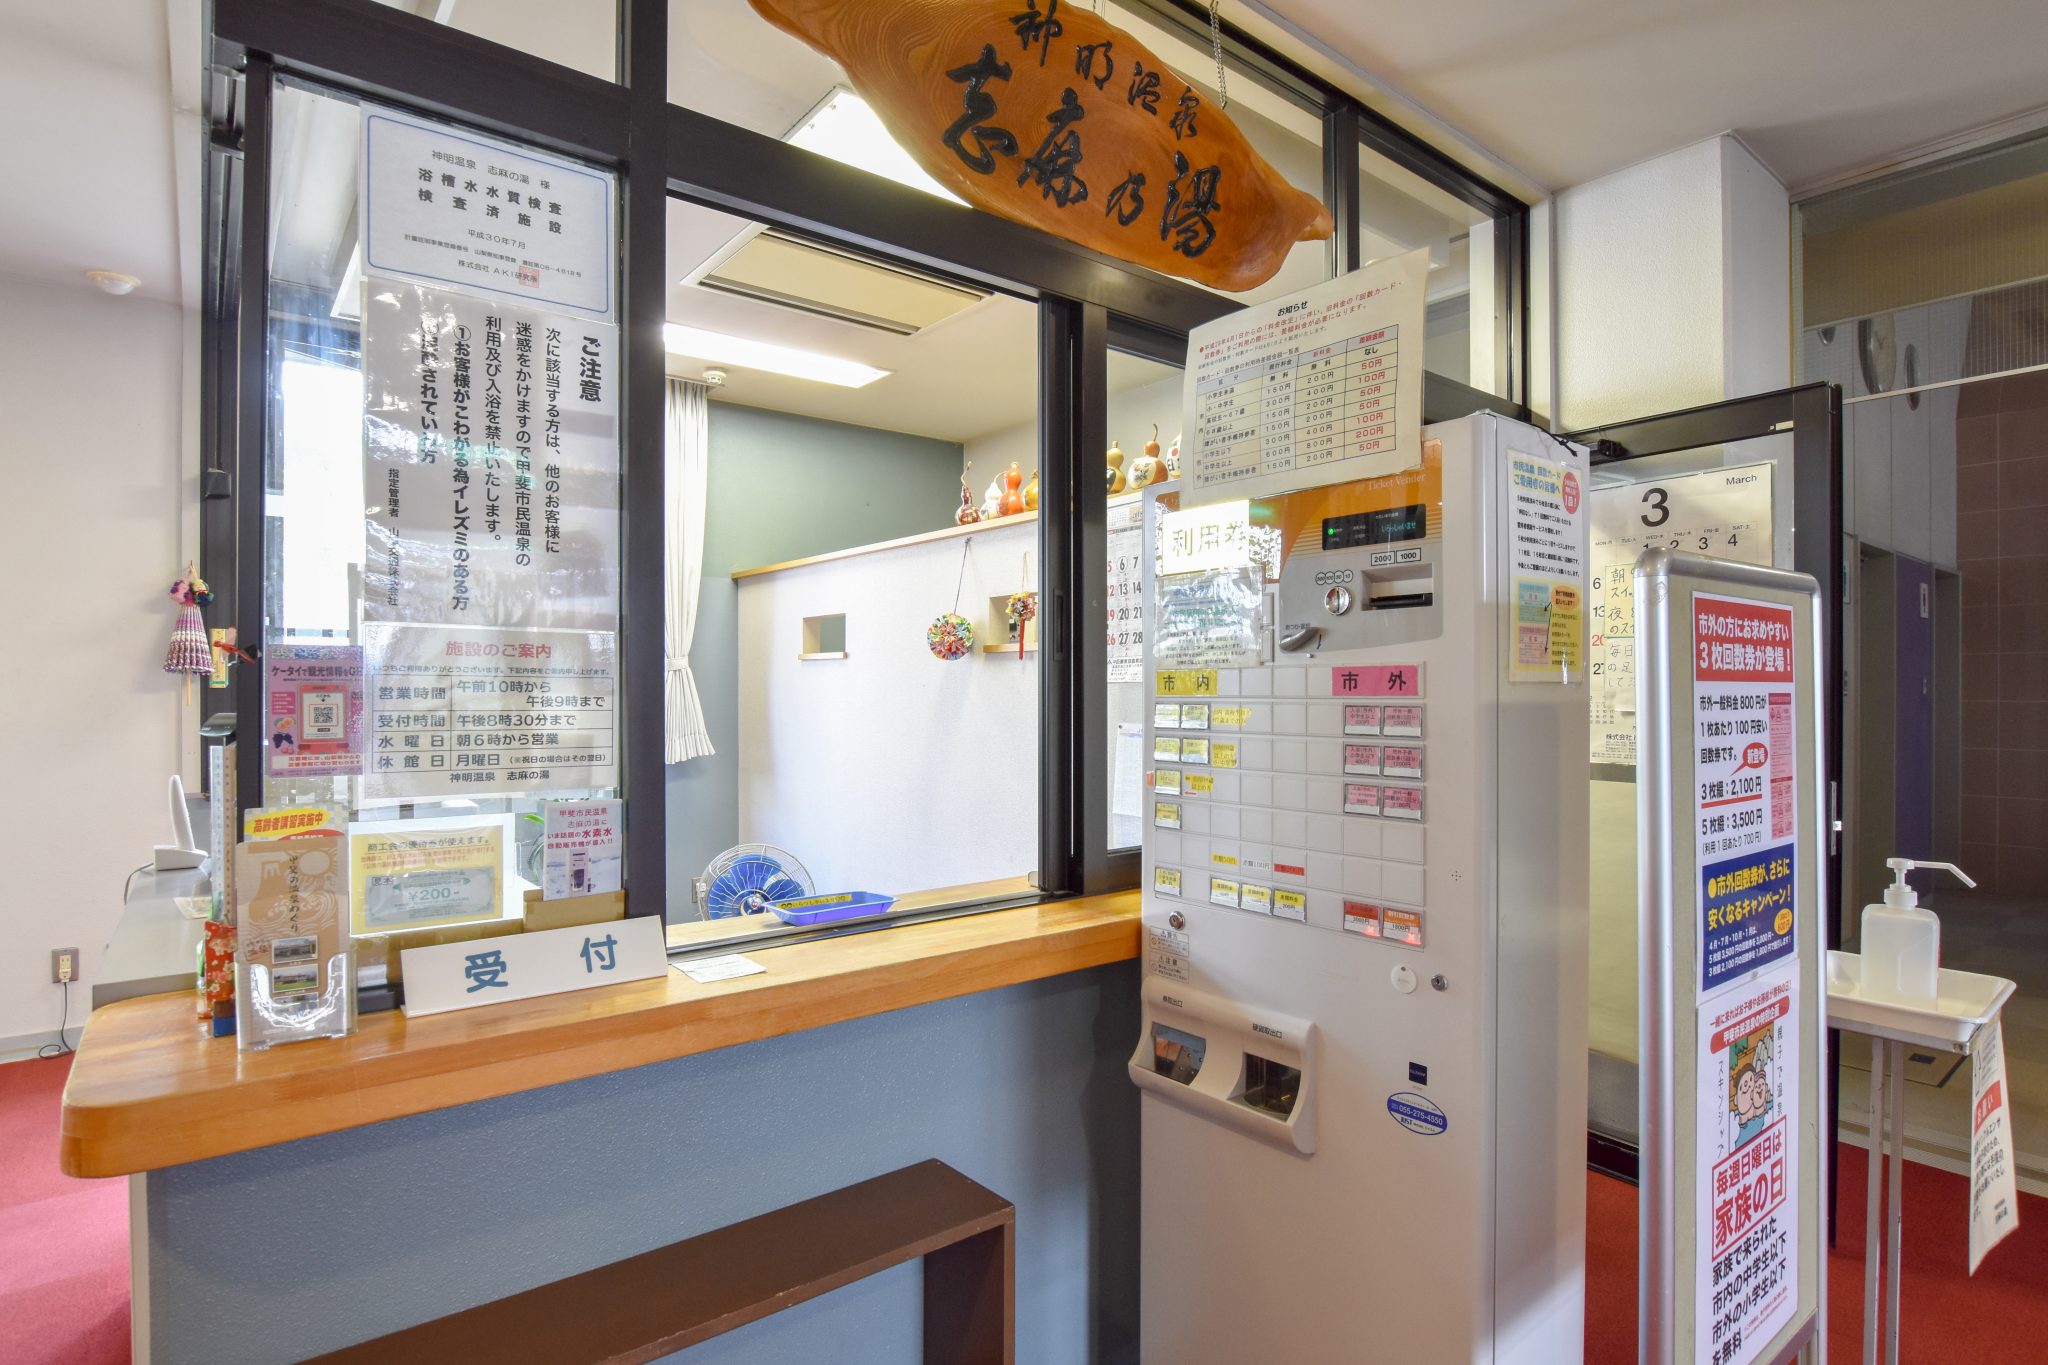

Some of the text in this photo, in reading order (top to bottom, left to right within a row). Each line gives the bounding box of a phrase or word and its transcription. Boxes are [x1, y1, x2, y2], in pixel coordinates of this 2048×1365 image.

[1009, 0, 1199, 141] 神明温泉
[942, 43, 1221, 258] 志麻乃湯
[431, 150, 477, 170] 神明温泉
[487, 164, 530, 185] 志麻の湯
[418, 167, 562, 216] 浴槽水水質検査
[418, 188, 562, 234] 検査済施設
[468, 228, 526, 250] 平成30年7月
[458, 259, 489, 273] 株式会社
[1277, 300, 1309, 317] お知らせ
[1364, 346, 1379, 355] なし
[579, 335, 602, 402] ご注意
[1307, 370, 1334, 384] 200円
[1361, 358, 1383, 370] 50円
[1307, 384, 1334, 397] 400円
[1359, 371, 1386, 384] 100円
[1306, 397, 1333, 410] 200円
[1360, 385, 1381, 397] 50円
[1306, 410, 1333, 423] 200円
[1359, 399, 1380, 410] 50円
[485, 315, 502, 541] 利用及び入浴を禁止いたします。
[1306, 424, 1333, 435] 400円
[1356, 412, 1384, 425] 100円
[1355, 425, 1384, 438] 200円
[515, 321, 532, 567] 迷惑をかけますので甲斐市民温泉の
[544, 327, 561, 554] 次に該当する方は、他のお客様に
[1306, 450, 1333, 462] 200円
[1359, 440, 1380, 452] 50円
[1726, 474, 1757, 486] March
[388, 468, 399, 518] 指定管理者
[1641, 487, 1670, 528] 3
[1698, 537, 1709, 550] 3
[1727, 533, 1738, 547] 4
[1119, 557, 1125, 571] 6
[1132, 556, 1138, 569] 7
[1374, 552, 1417, 563] 2000 1000
[1592, 577, 1601, 590] 6
[1611, 568, 1625, 584] 朝
[1118, 581, 1142, 596] 13 14
[1118, 608, 1129, 621] 20
[1608, 606, 1624, 621] 夜
[1698, 612, 1789, 641] 市外の方にお求めやすい
[1118, 633, 1129, 645] 27
[1132, 631, 1142, 644] 28
[446, 640, 552, 659] 施設のご案内
[1699, 641, 1791, 672] 3枚回数券が登場!
[379, 679, 551, 700] 営業時間 午前10時から
[1163, 674, 1210, 692] 市内
[1341, 671, 1407, 692] 市外
[526, 695, 605, 708] 午後9時まで
[1699, 694, 1767, 711] 市外一般料金800円が
[378, 713, 577, 728] 受付時間 午後8時30分まで
[1700, 719, 1768, 738] 1枚あたり100円安い
[378, 733, 559, 749] 水曜日 朝6時から営業
[378, 754, 445, 769] 休館日
[456, 753, 501, 767] 月曜日
[1700, 747, 1737, 765] 回数券です。
[450, 770, 550, 783] 神明温泉 志麻の湯
[253, 811, 324, 833] 高齢者講習実施中
[559, 807, 607, 818] 甲斐市民温泉
[567, 819, 607, 829] 志麻の湯に
[1708, 884, 1791, 932] 安くなるキャンペーン!
[464, 934, 618, 994] 受付
[1398, 1104, 1443, 1126] 055-275-4550
[1716, 1131, 1783, 1198] 毎週日曜日は
[1715, 1156, 1783, 1249] 家族の日
[1712, 1216, 1777, 1287] 家族で来られた
[1712, 1231, 1787, 1316] 市内の中学生以下
[1712, 1258, 1787, 1346] 市外の小学生以下
